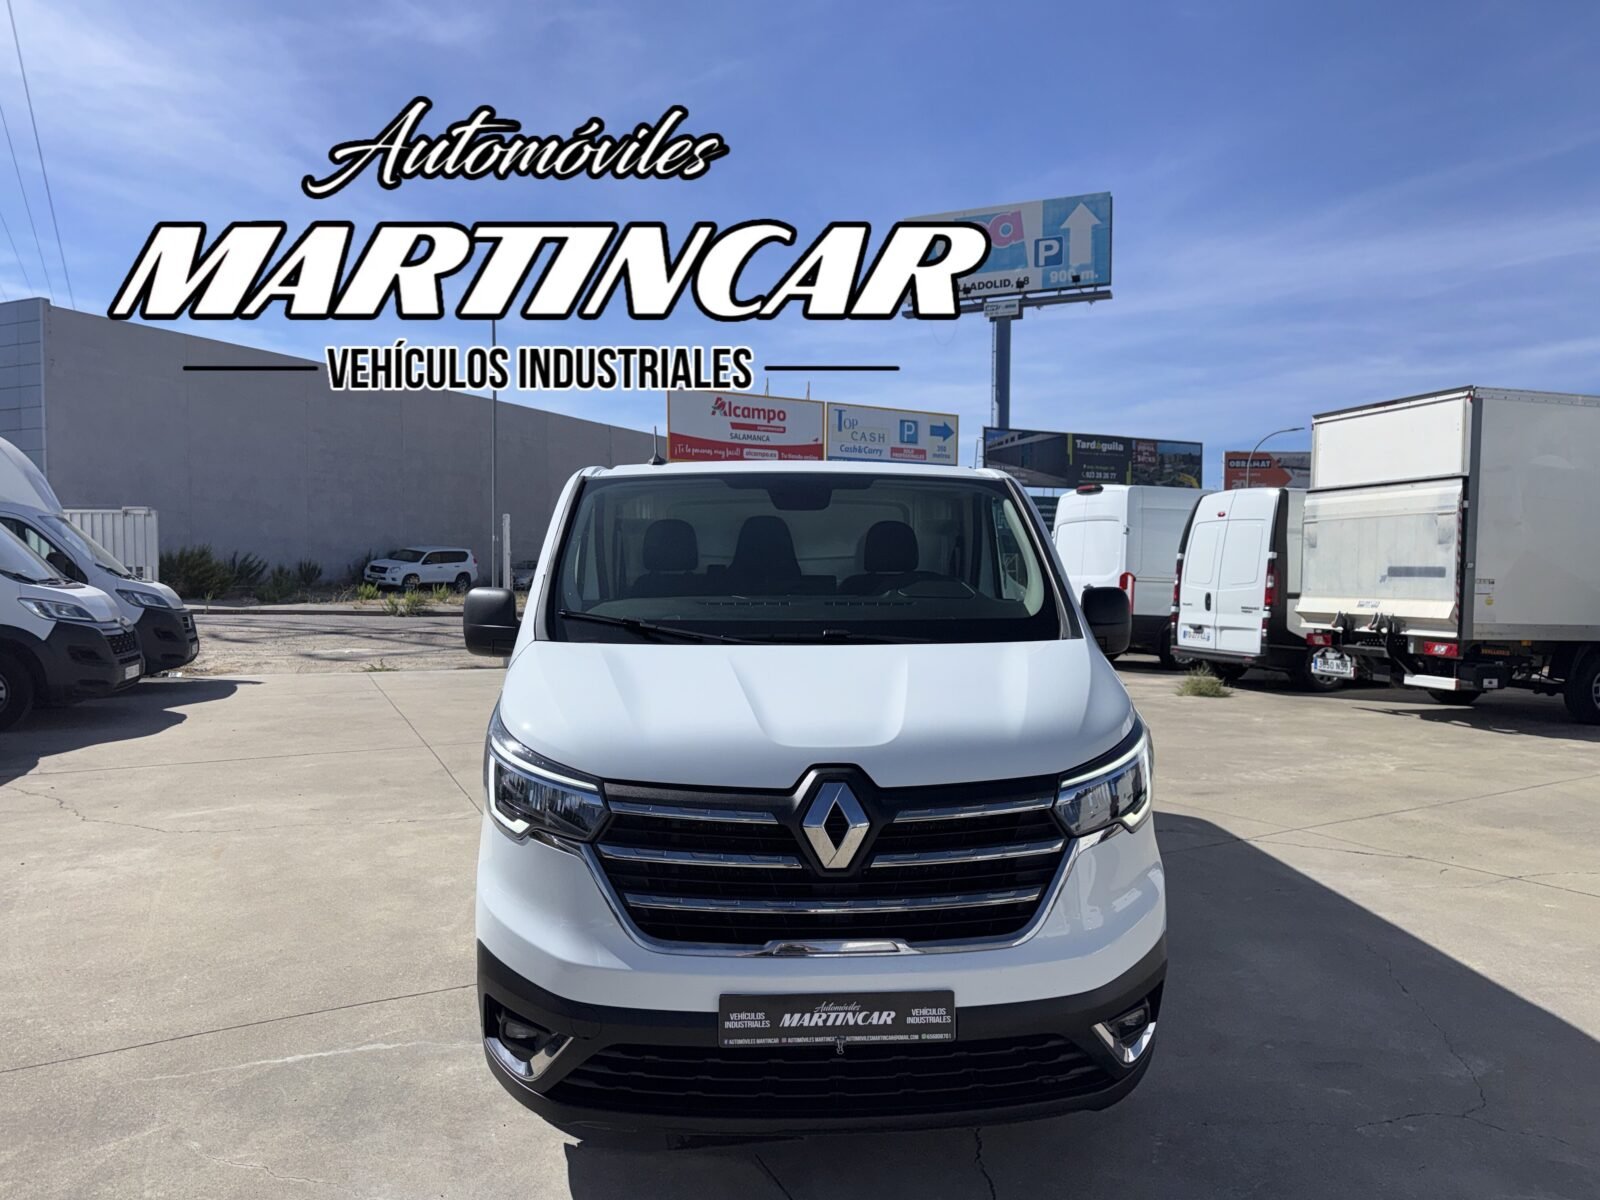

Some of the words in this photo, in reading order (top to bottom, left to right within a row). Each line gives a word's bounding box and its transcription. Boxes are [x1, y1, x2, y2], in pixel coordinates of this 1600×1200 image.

[1038, 239, 1060, 266] P
[711, 396, 787, 423] Alcampo
[729, 432, 771, 442] SALAMANCA
[850, 431, 886, 443] CASH
[903, 421, 915, 442] P
[839, 444, 883, 456] Cash&Carry
[1229, 460, 1271, 468] OBRAMAT
[813, 1001, 862, 1013] Automóviles
[911, 1007, 947, 1016] VEHÍCULOS
[724, 1020, 771, 1029] INDUSTRIALES
[729, 1012, 766, 1021] VEHÍCULOS
[778, 1011, 896, 1028] MARTINCAR
[906, 1015, 952, 1025] INDUSTRIALES
